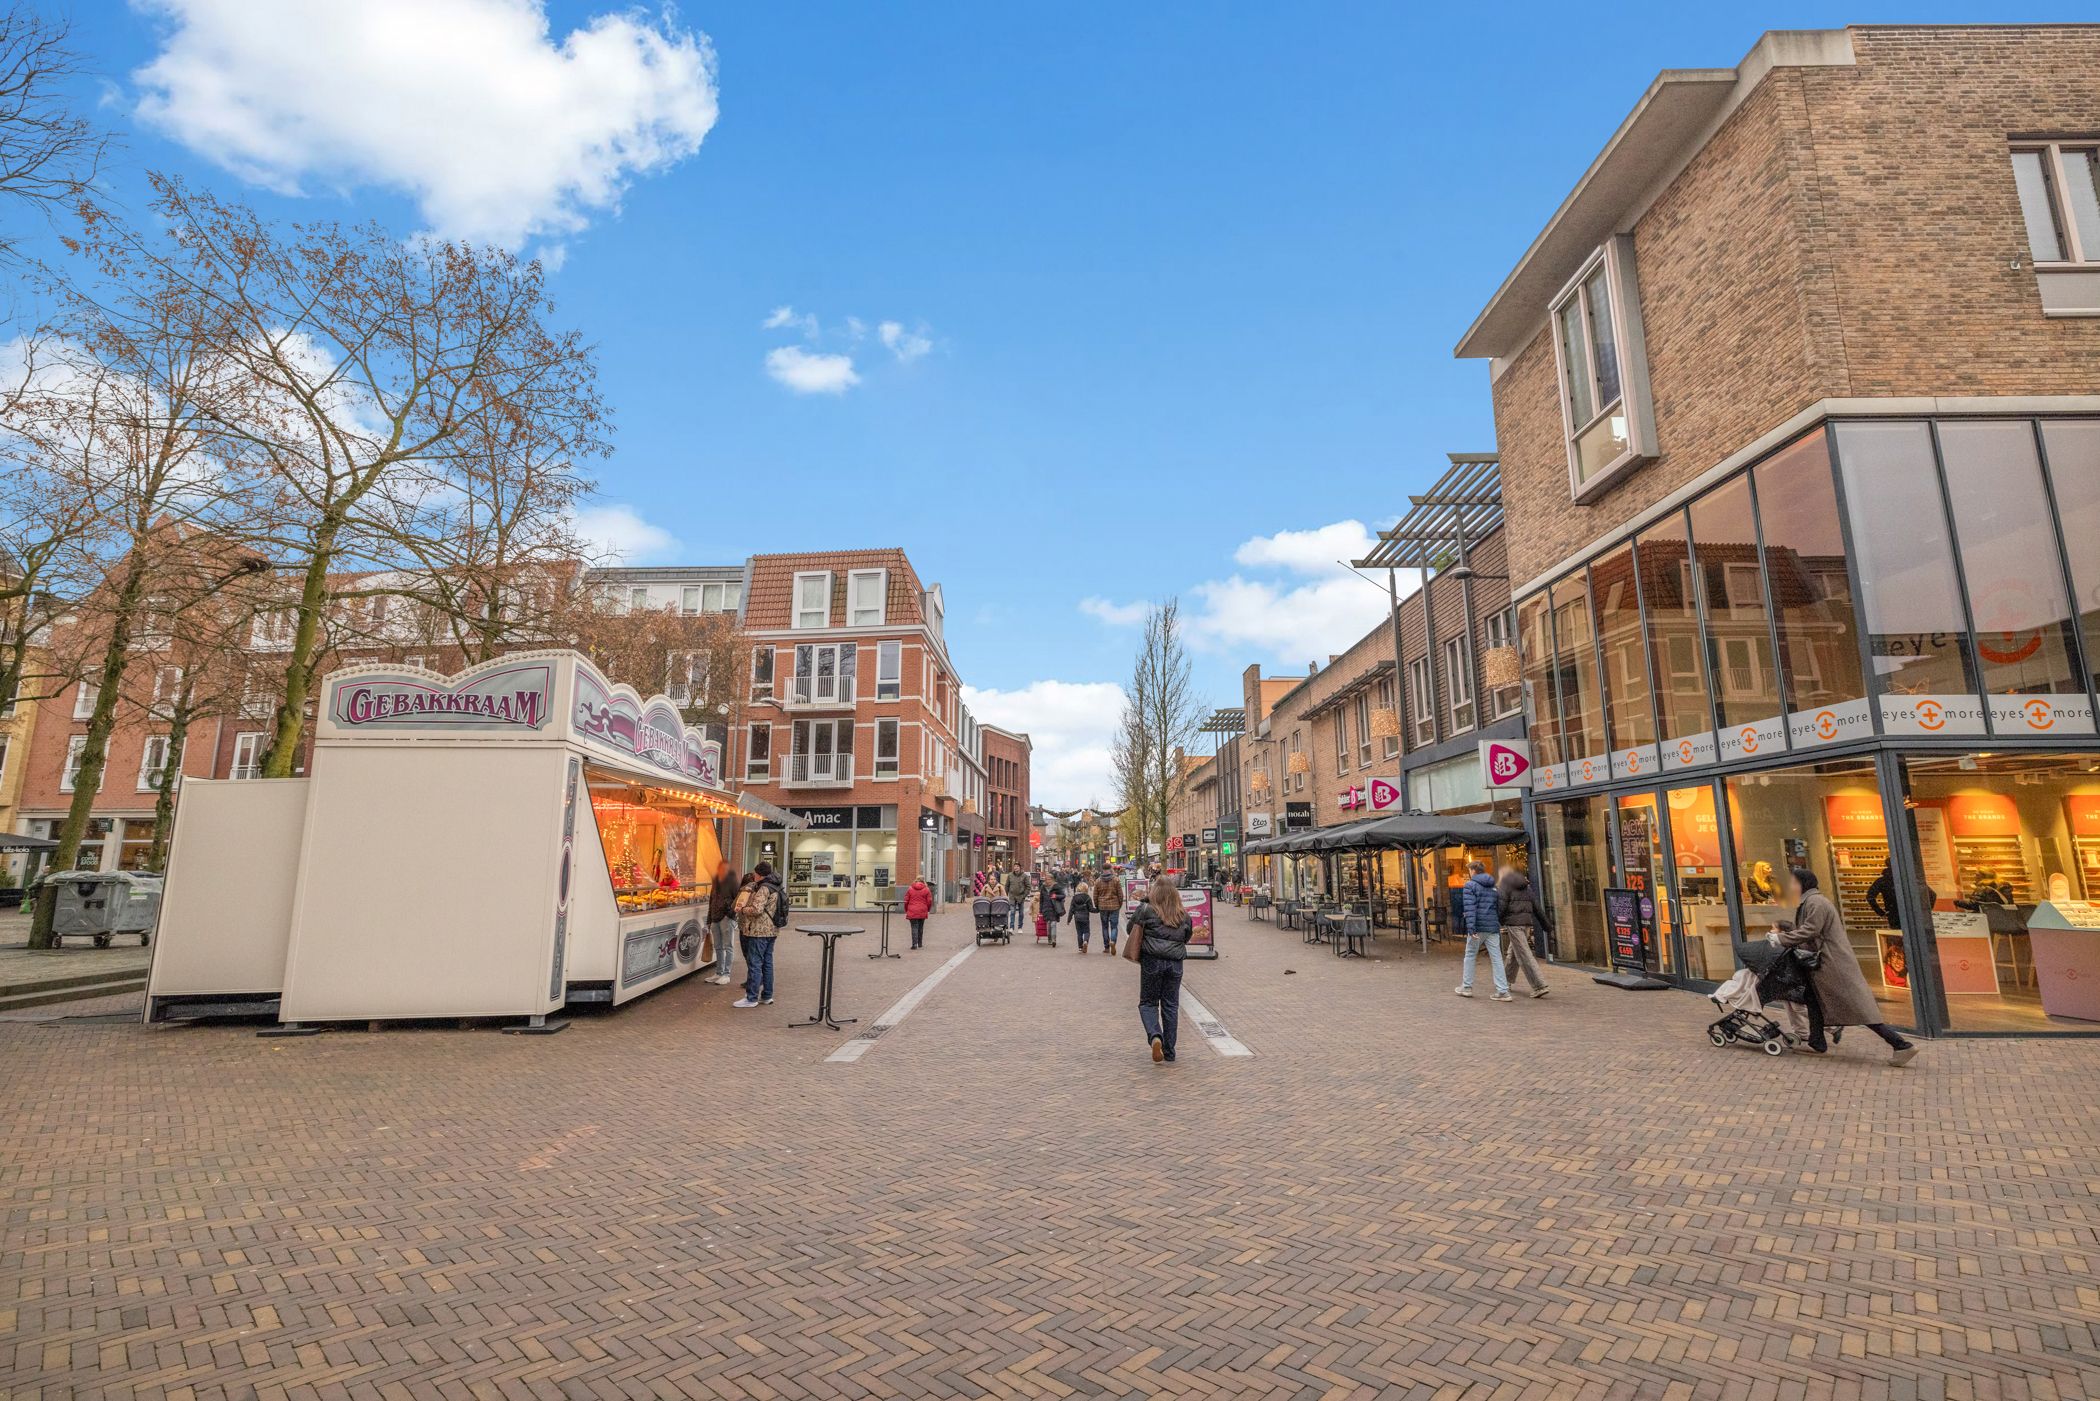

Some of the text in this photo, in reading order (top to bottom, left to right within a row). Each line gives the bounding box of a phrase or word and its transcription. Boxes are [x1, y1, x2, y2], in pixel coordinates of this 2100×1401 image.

[349, 688, 540, 729] GEBAKKRAAM
[1882, 710, 1984, 721] eyes more
[1990, 709, 2092, 721] eyes more
[1791, 712, 1868, 737] eyes more
[1720, 729, 1783, 750] eyes more
[1662, 743, 1714, 760] eyes more
[1613, 755, 1657, 768] eyes more
[803, 811, 841, 826] Amac
[1288, 810, 1310, 818] norah
[1252, 818, 1267, 828] Etos
